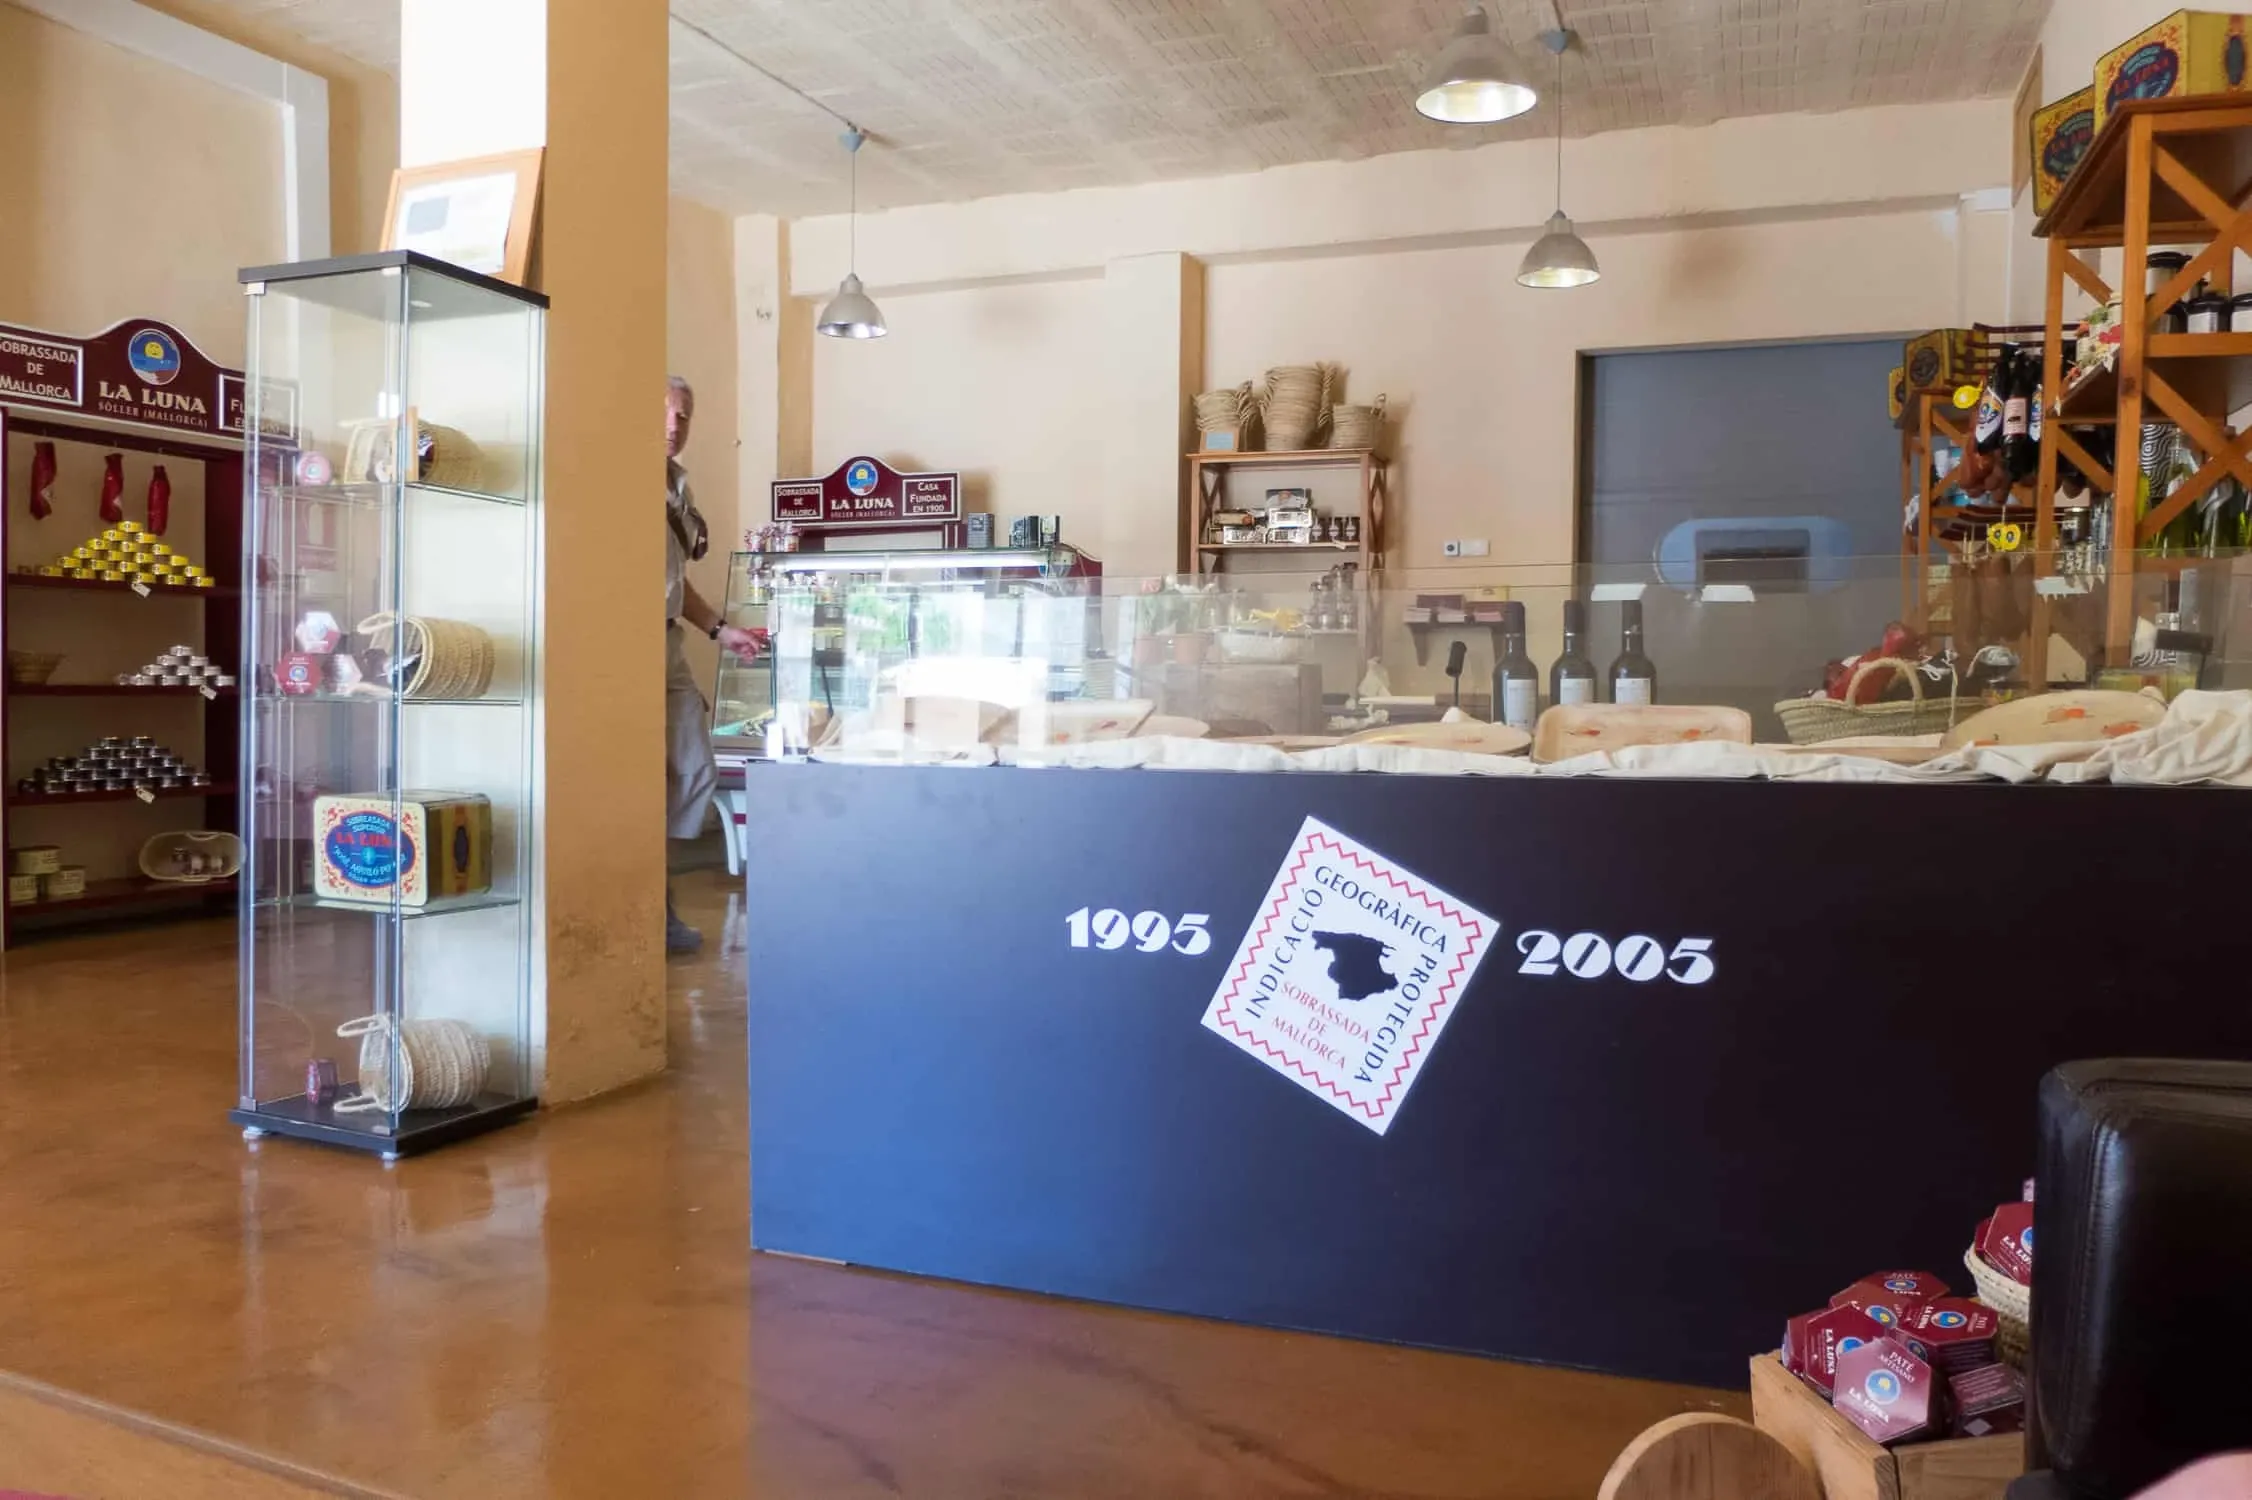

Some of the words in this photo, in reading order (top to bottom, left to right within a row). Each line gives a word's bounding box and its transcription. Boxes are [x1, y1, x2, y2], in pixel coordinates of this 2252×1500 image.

[0, 341, 77, 364] OBRASSADA
[27, 362, 45, 376] DE
[0, 375, 72, 399] MALLORCA
[99, 381, 133, 402] LA
[142, 388, 208, 414] LUNA
[910, 494, 948, 503] FUNDADA
[918, 482, 939, 492] CASA
[831, 499, 850, 510] LA
[855, 497, 895, 510] LUNA
[912, 505, 923, 513] EN
[1315, 865, 1447, 952] GEOGRÀFICA
[1065, 907, 1212, 955] 1995
[1517, 930, 1715, 985] 2005
[1246, 887, 1323, 1019] INDICACIÓ
[1282, 981, 1371, 1043] SOBRASSADA
[1354, 953, 1437, 1084] PROTEGIDA
[1308, 1018, 1328, 1037] DE
[1271, 1016, 1346, 1069] MALLORCA
[1825, 1328, 1834, 1343] LA
